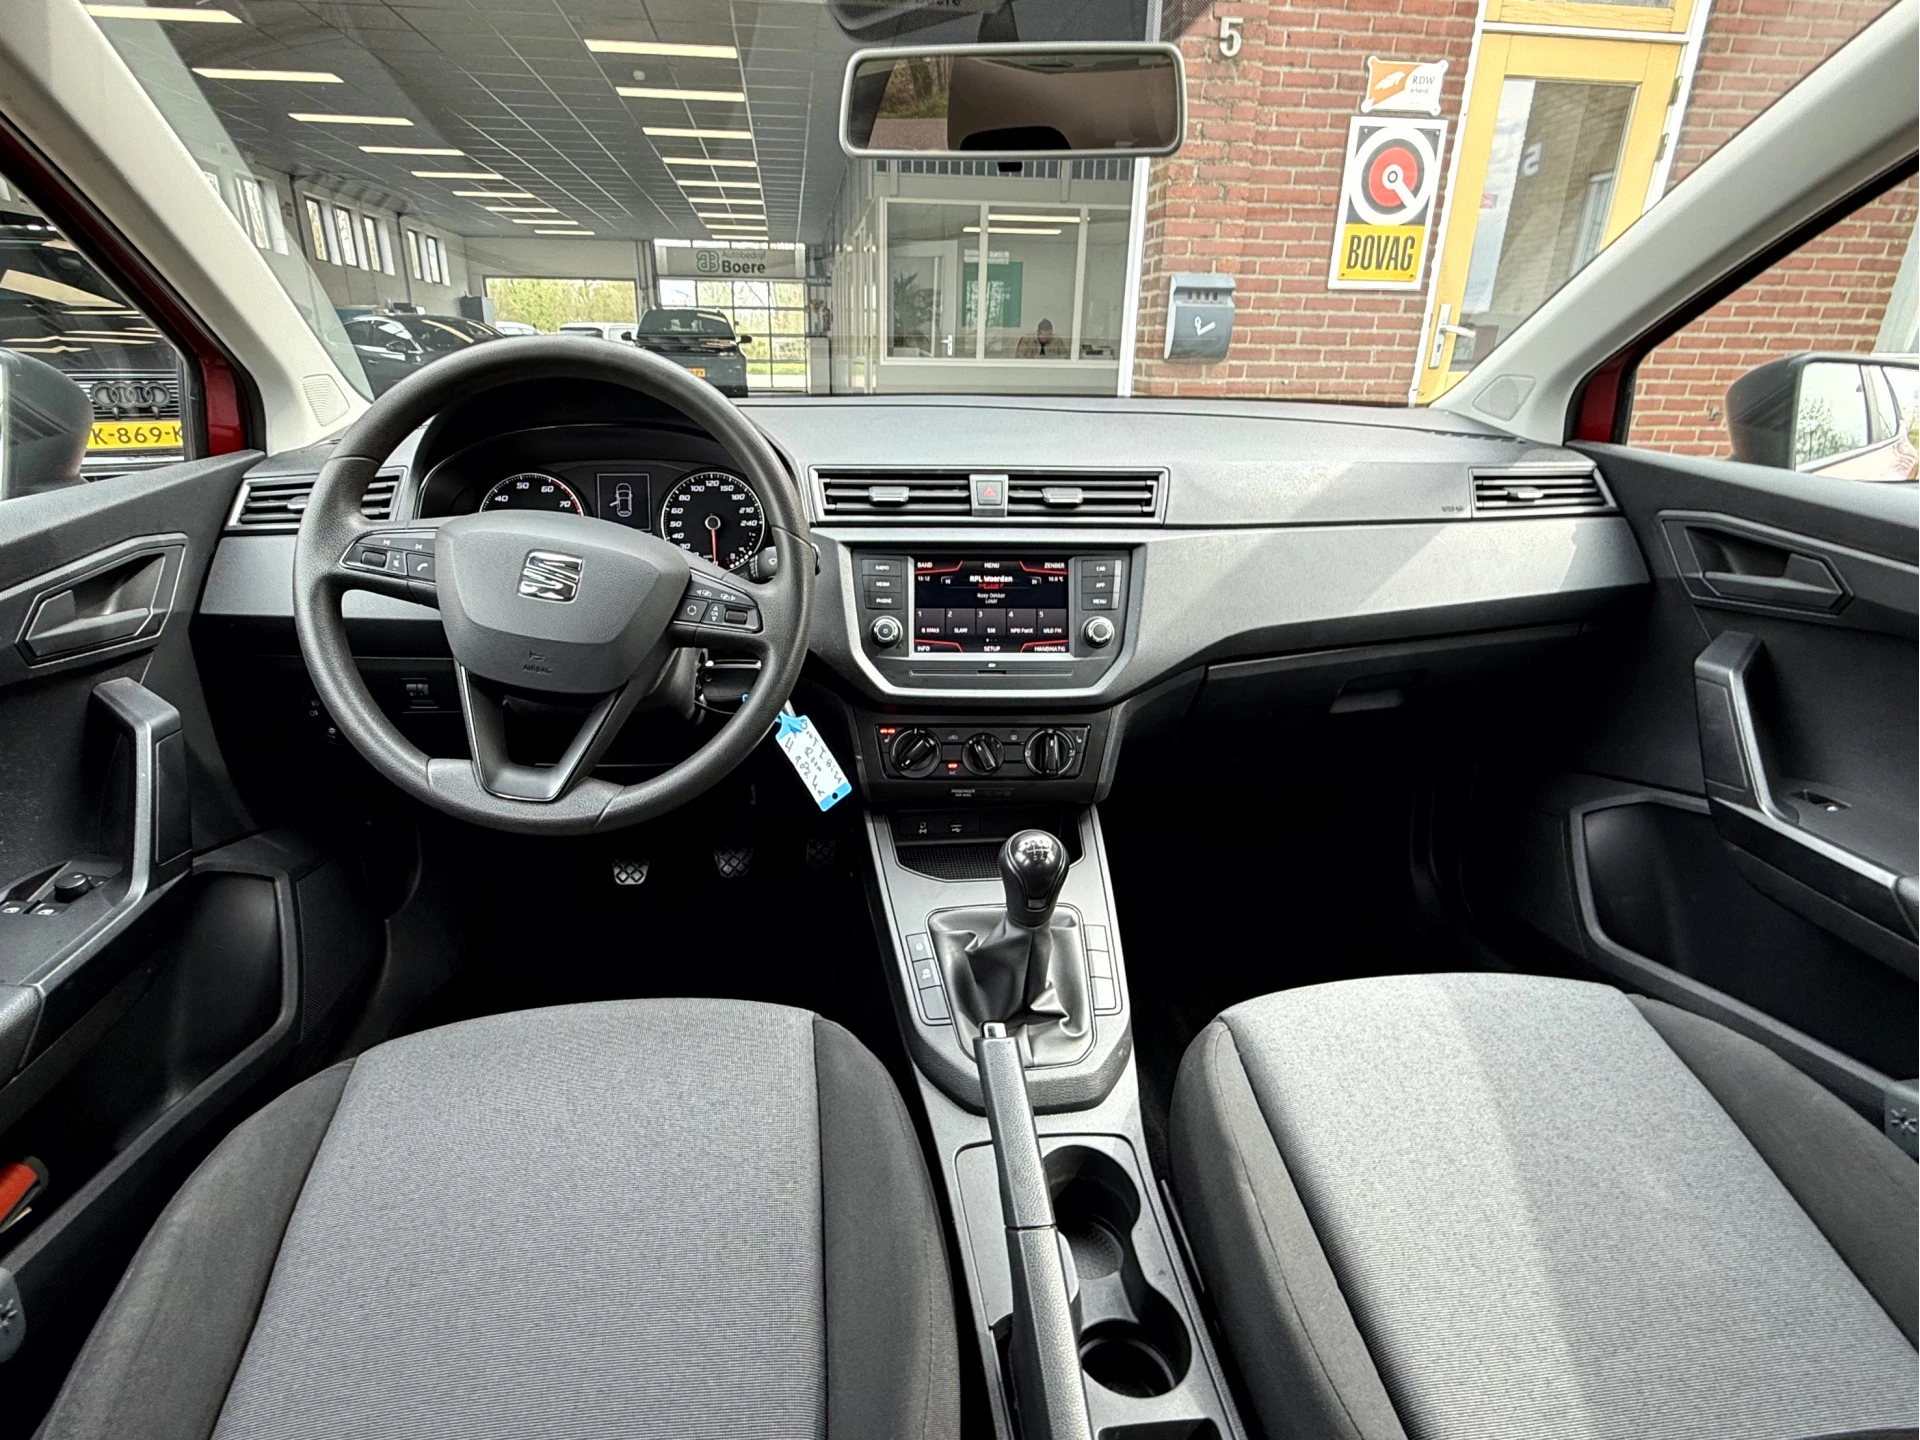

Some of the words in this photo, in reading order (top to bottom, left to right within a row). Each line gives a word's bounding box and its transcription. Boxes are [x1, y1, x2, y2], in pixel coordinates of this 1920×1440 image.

[1219, 16, 1244, 57] 5
[1411, 75, 1436, 85] RDW
[722, 250, 766, 260] Autobedrijf
[1346, 234, 1416, 272] BOVAG
[722, 260, 766, 274] Boere
[516, 482, 530, 490] 50
[541, 485, 554, 493] 60
[983, 575, 1013, 583] Woerden
